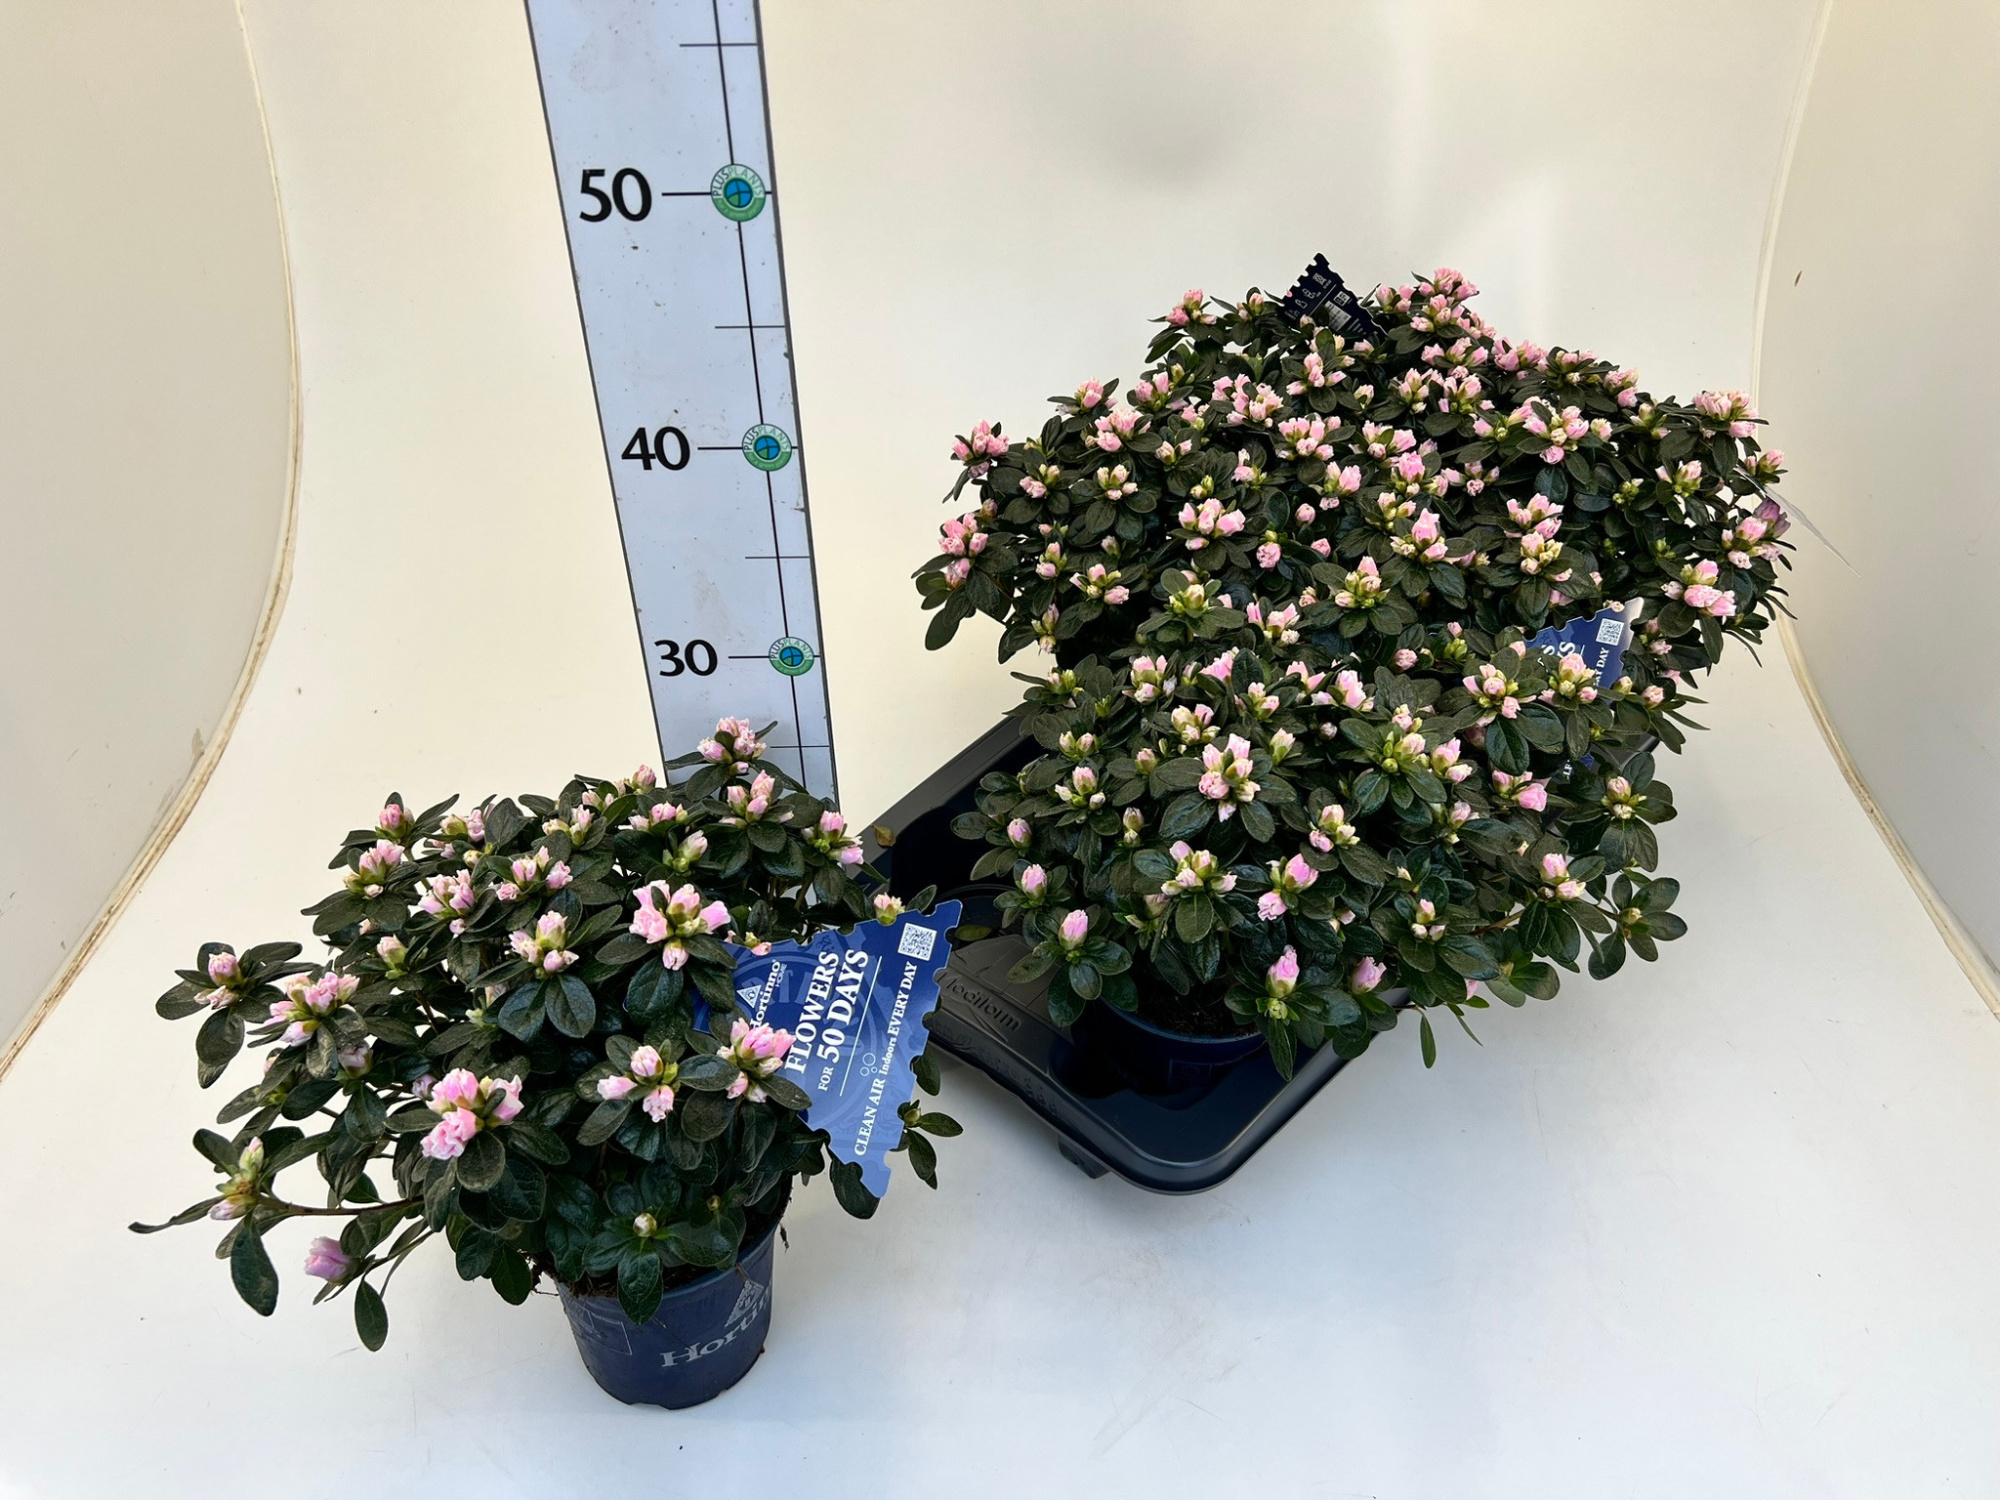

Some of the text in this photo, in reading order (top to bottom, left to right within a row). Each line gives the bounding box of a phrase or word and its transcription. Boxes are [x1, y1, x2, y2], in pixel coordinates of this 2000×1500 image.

[579, 167, 653, 223] 50
[621, 426, 691, 471] 40
[654, 639, 718, 677] 30
[1596, 647, 1610, 669] DAY
[784, 951, 840, 1075] FLOWERS
[816, 949, 869, 1092] FOR 50 DAYS
[854, 960, 918, 1156] CLEAN AIR Indoors EVERY DAY
